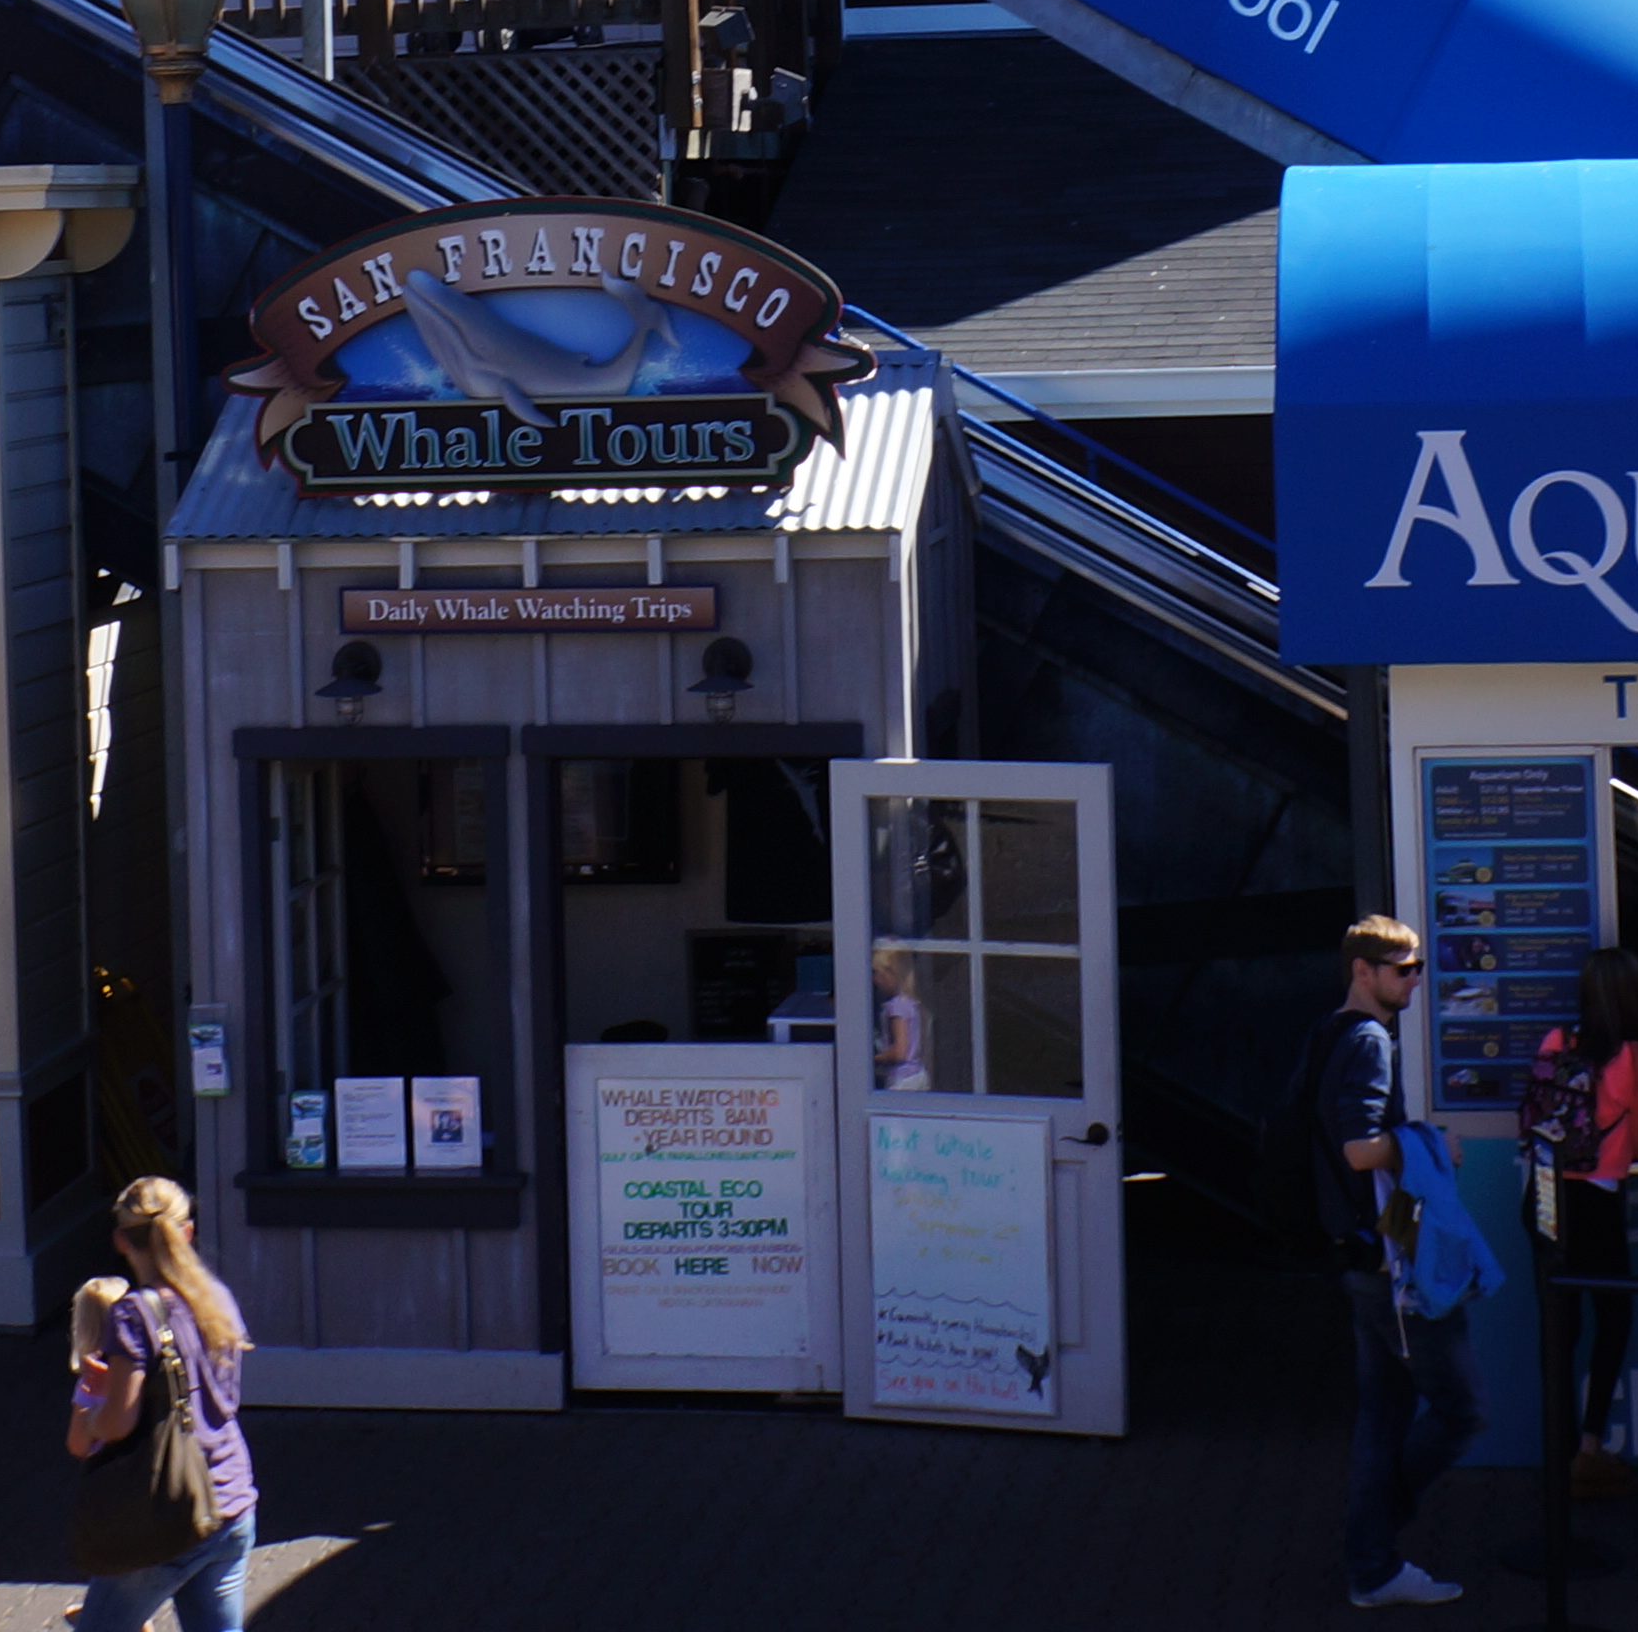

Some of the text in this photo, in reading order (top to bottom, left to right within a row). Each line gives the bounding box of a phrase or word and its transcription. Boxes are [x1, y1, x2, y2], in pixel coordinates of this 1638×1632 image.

[298, 226, 791, 340] SAN FRANCISCO
[326, 407, 756, 471] Whale Tours
[367, 595, 693, 624] Daily Whale Watching Trips
[602, 1089, 779, 1108] WHALE WATCHING
[625, 1108, 768, 1127] DEPARTS 8AM
[644, 1127, 774, 1147] YEAR ROUND
[624, 1179, 763, 1199] COASTAL ECO
[678, 1200, 734, 1219] TOUR
[624, 1220, 713, 1240] DEPARTS
[602, 1255, 804, 1276] BOOK HERE NOW
